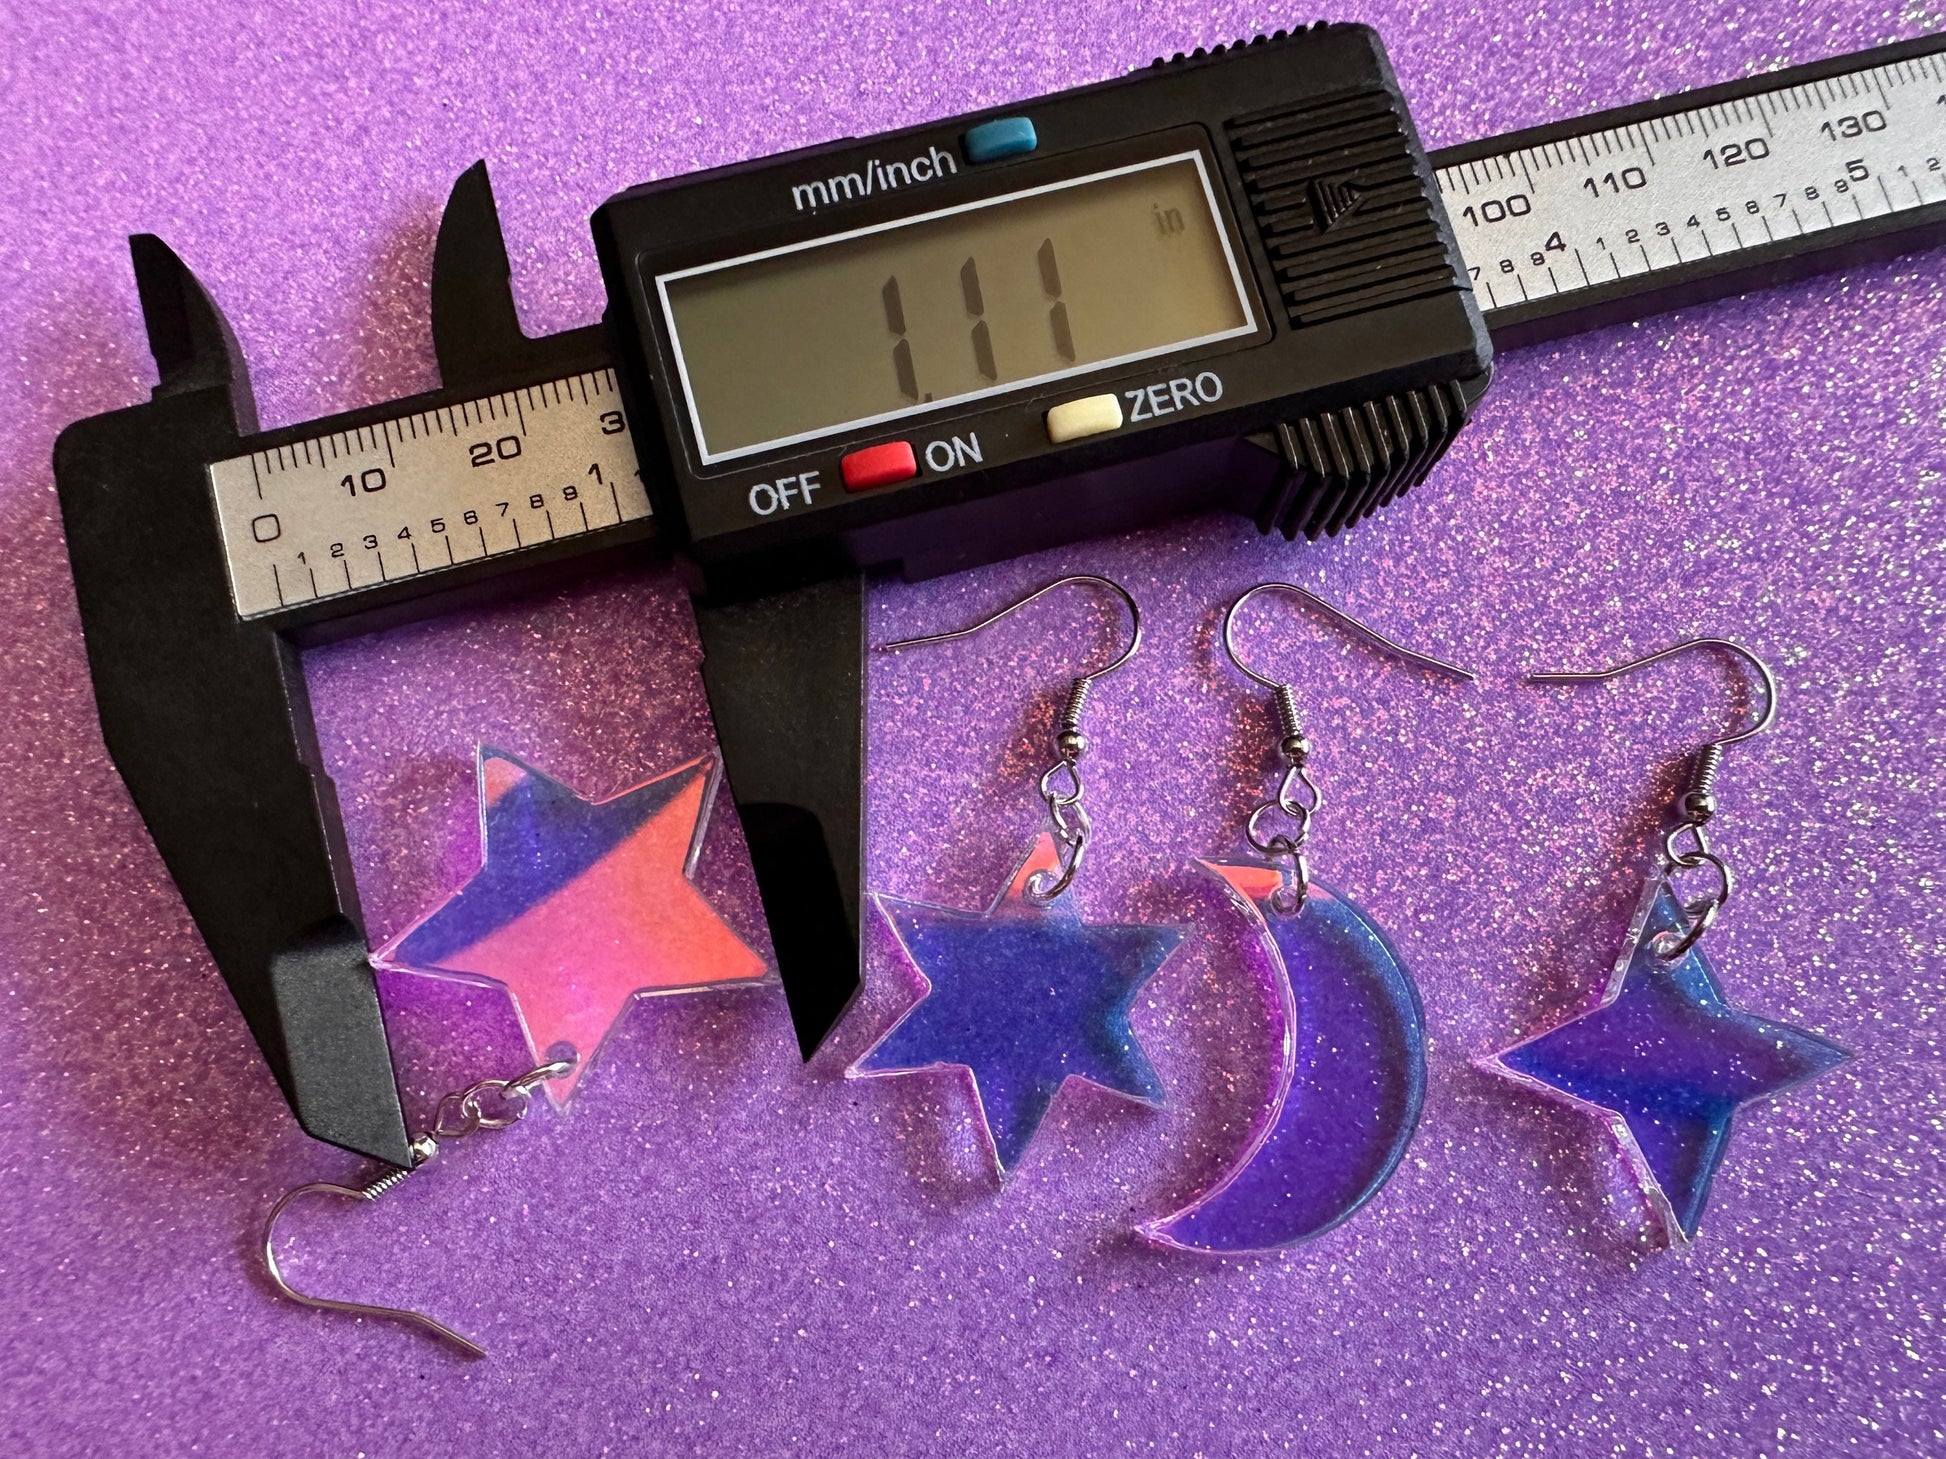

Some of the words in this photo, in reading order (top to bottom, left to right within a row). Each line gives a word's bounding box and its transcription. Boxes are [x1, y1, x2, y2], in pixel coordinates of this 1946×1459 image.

[790, 146, 959, 211] mm/inch
[1462, 193, 1532, 227] 100
[1583, 166, 1648, 198] 110
[1702, 137, 1771, 170] 120
[1820, 109, 1888, 142] 130
[1152, 202, 1186, 236] in
[1500, 258, 1515, 274] 8
[1544, 231, 1567, 252] 4
[1596, 236, 1606, 250] 1
[1625, 228, 1641, 244] 2
[1655, 221, 1671, 236] 3
[1686, 214, 1701, 228] 4
[1715, 206, 1731, 222] 5
[1772, 192, 1787, 208] 7
[1804, 185, 1820, 201] 8
[1845, 158, 1870, 182] 5
[1926, 157, 1942, 172] 2
[881, 237, 1076, 403] 1.11
[1124, 371, 1225, 423] ZERO
[340, 467, 387, 497] 10
[468, 434, 523, 468] 20
[923, 431, 985, 473] ON
[297, 551, 306, 564] 1
[330, 542, 345, 558] 2
[363, 534, 379, 550] 3
[397, 526, 412, 540] 4
[430, 517, 446, 533] 5
[495, 502, 509, 517] 7
[529, 493, 544, 509] 8
[562, 485, 578, 501] 9
[588, 463, 603, 485] 1
[747, 470, 822, 517] OFF
[252, 513, 282, 544] 0
